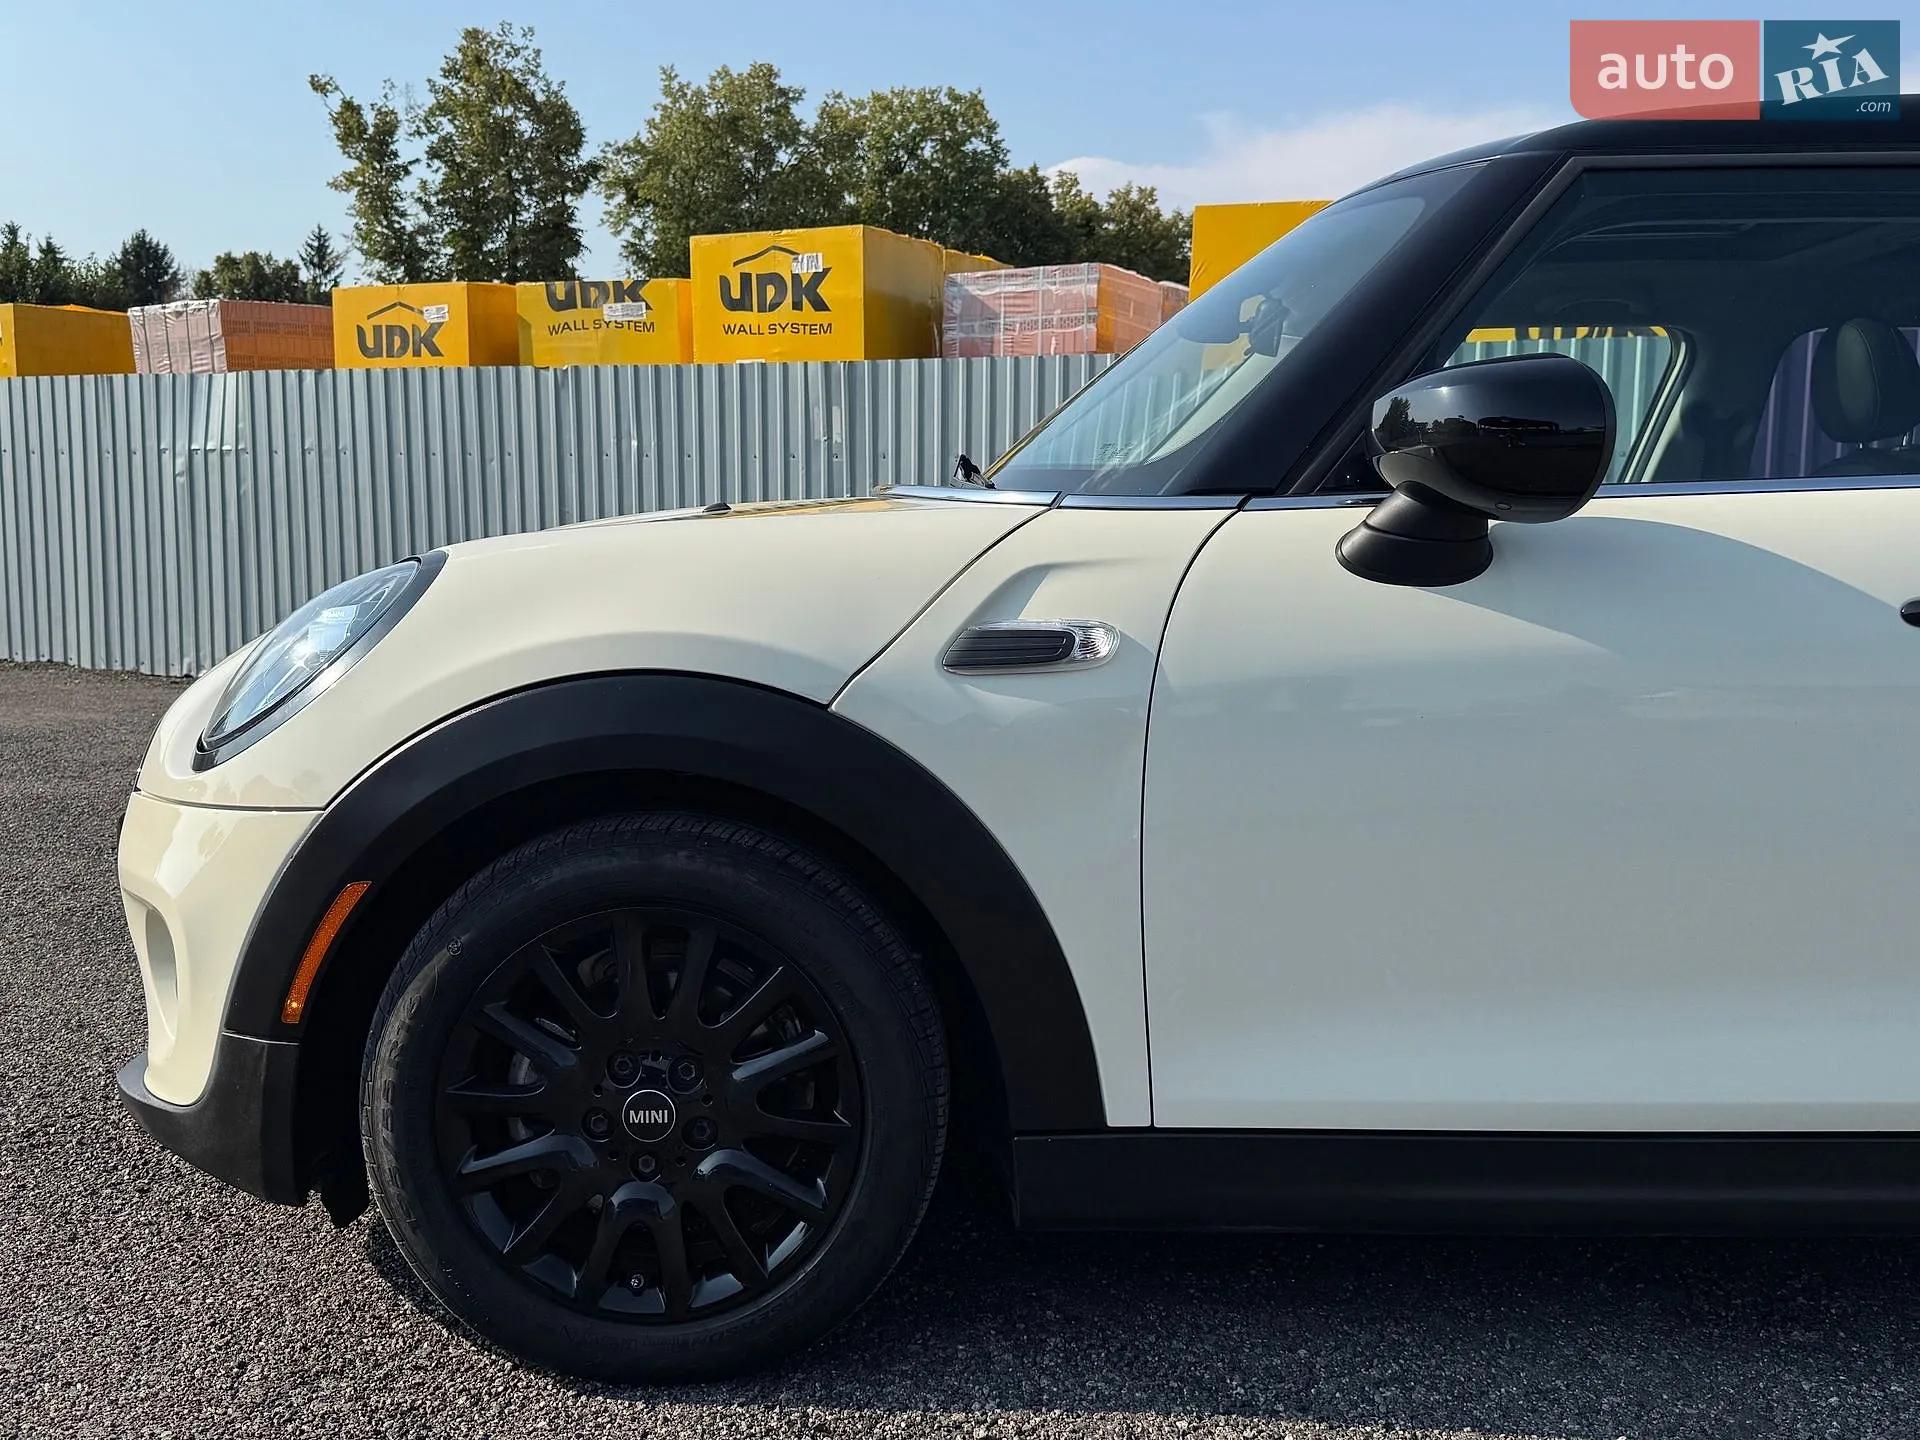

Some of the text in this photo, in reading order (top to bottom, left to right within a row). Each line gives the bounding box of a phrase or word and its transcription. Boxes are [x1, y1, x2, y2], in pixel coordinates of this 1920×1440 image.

[545, 280, 653, 312] UDK
[719, 267, 832, 313] UDK
[548, 319, 655, 336] WALL SYSTEM
[723, 322, 832, 336] WALL SYSTEM
[356, 322, 445, 358] UDK
[629, 1110, 669, 1124] MINI
